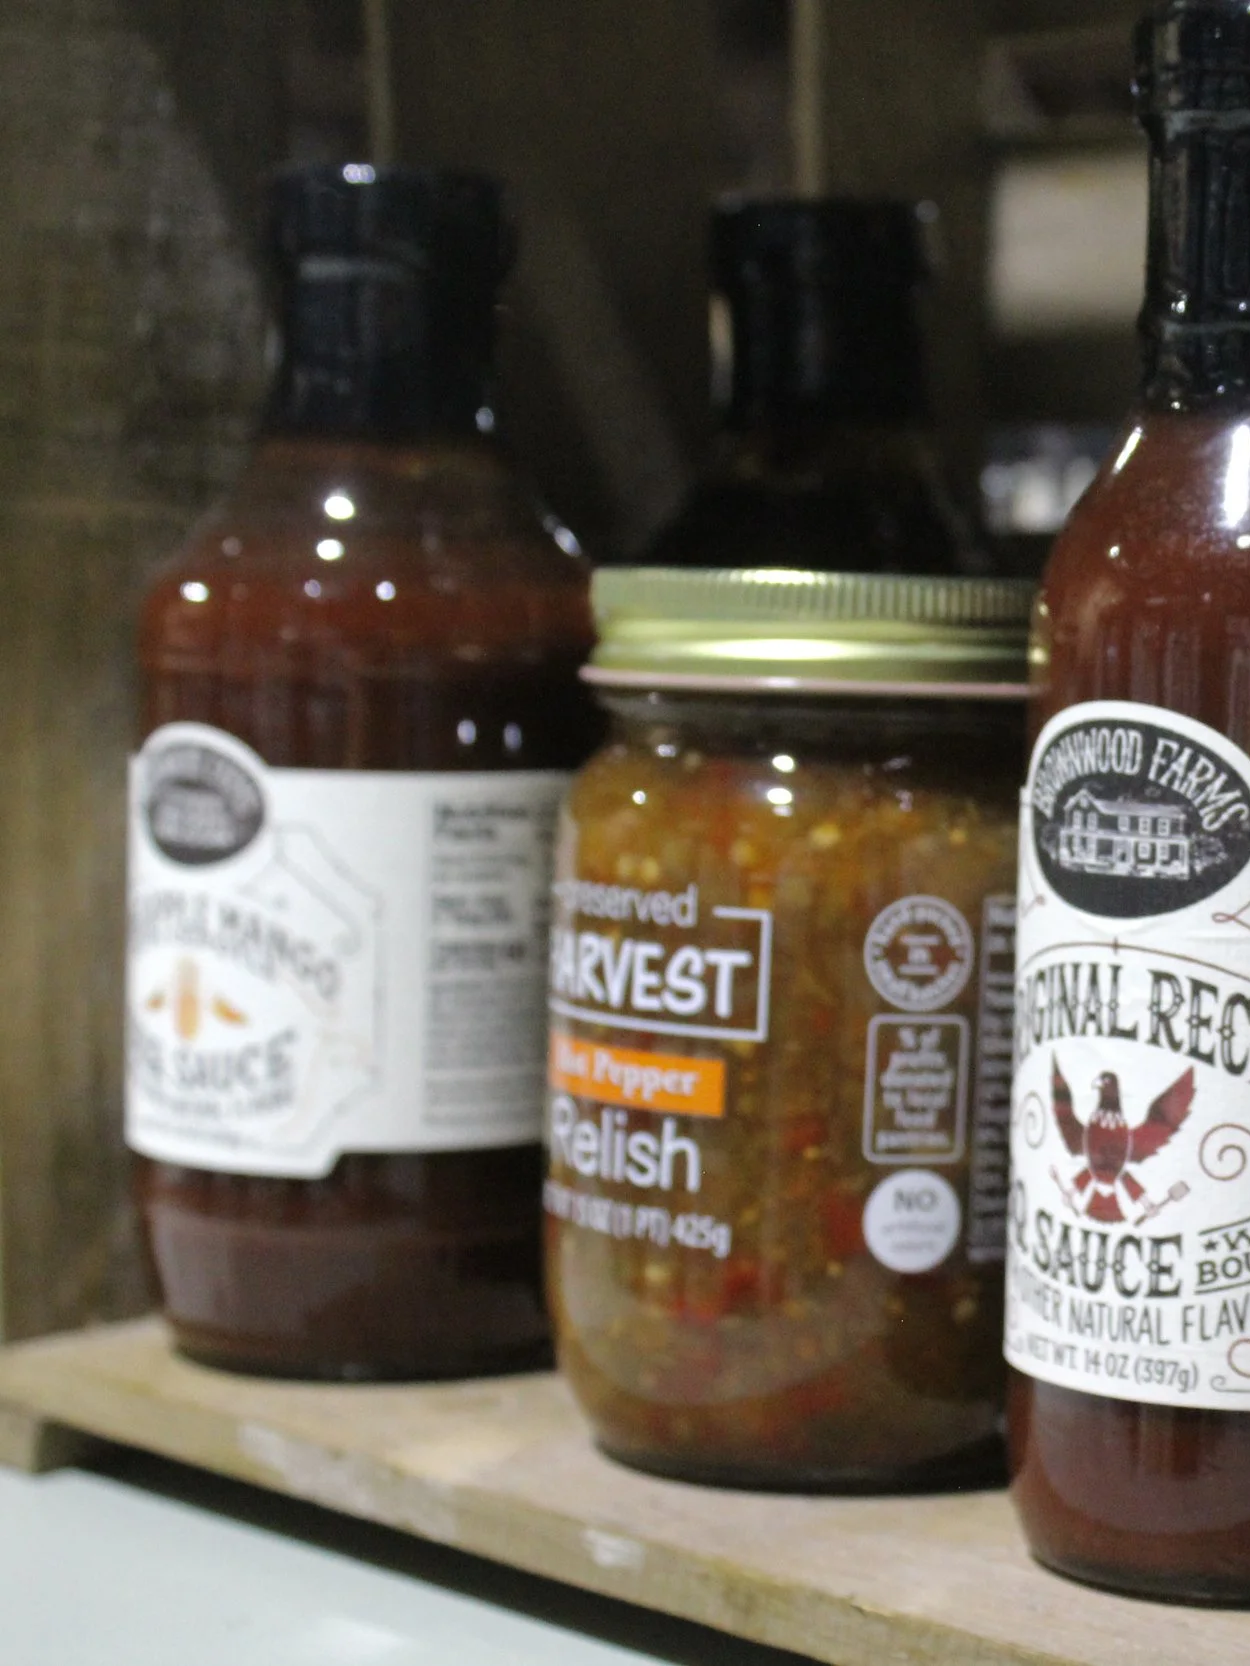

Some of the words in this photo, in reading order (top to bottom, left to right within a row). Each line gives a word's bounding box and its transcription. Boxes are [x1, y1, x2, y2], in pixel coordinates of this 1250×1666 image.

[1147, 736, 1250, 832] FARMS
[592, 1047, 699, 1100] Pepper
[894, 1188, 938, 1212] NO
[1032, 1207, 1183, 1299] SAUCE
[1068, 1296, 1171, 1346] NATURAL
[1083, 1347, 1101, 1376] 14
[1104, 1353, 1130, 1380] OZ
[1133, 1355, 1199, 1393] (397g)
